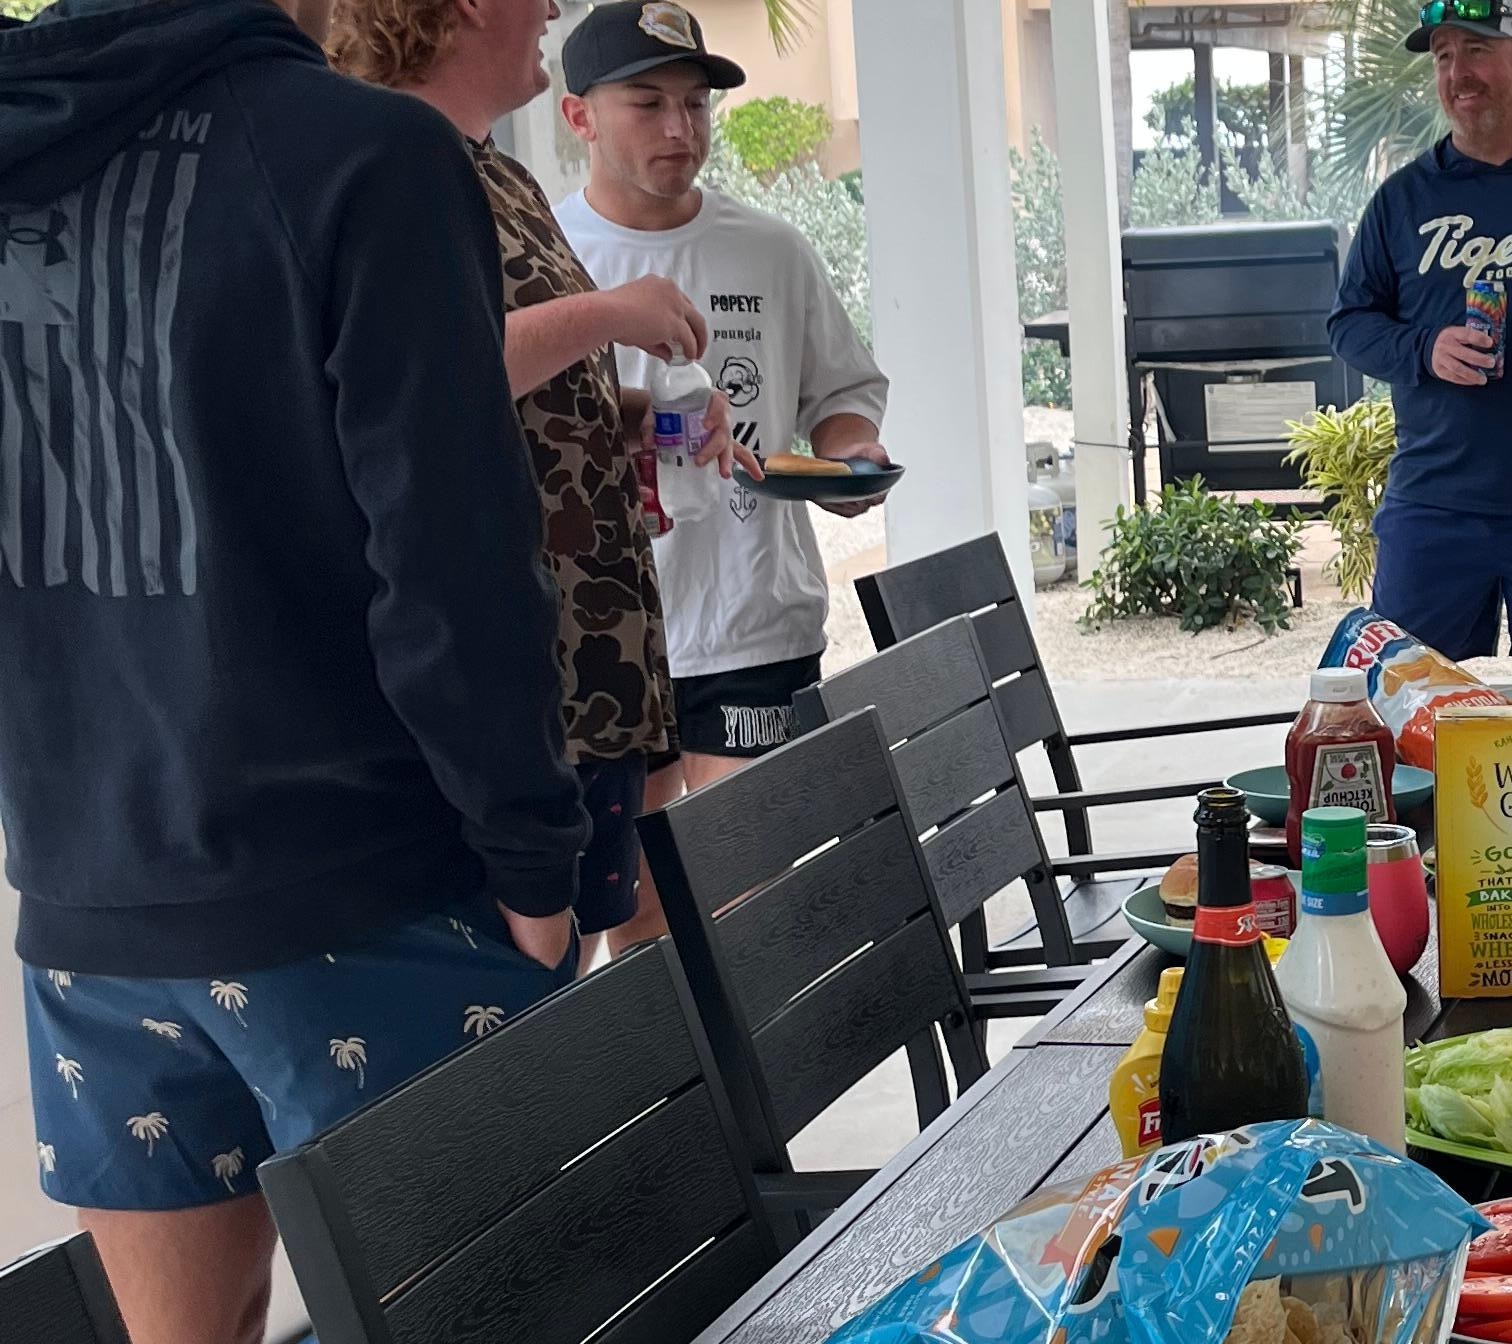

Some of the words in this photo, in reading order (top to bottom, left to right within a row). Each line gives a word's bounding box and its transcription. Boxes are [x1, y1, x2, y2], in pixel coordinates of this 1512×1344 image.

[710, 294, 763, 313] POPEYE
[1345, 621, 1402, 669] RUFF
[720, 704, 795, 748] YOUN
[1323, 790, 1373, 803] KETCHUP
[1478, 877, 1512, 887] THAT
[1485, 960, 1512, 968] LESS
